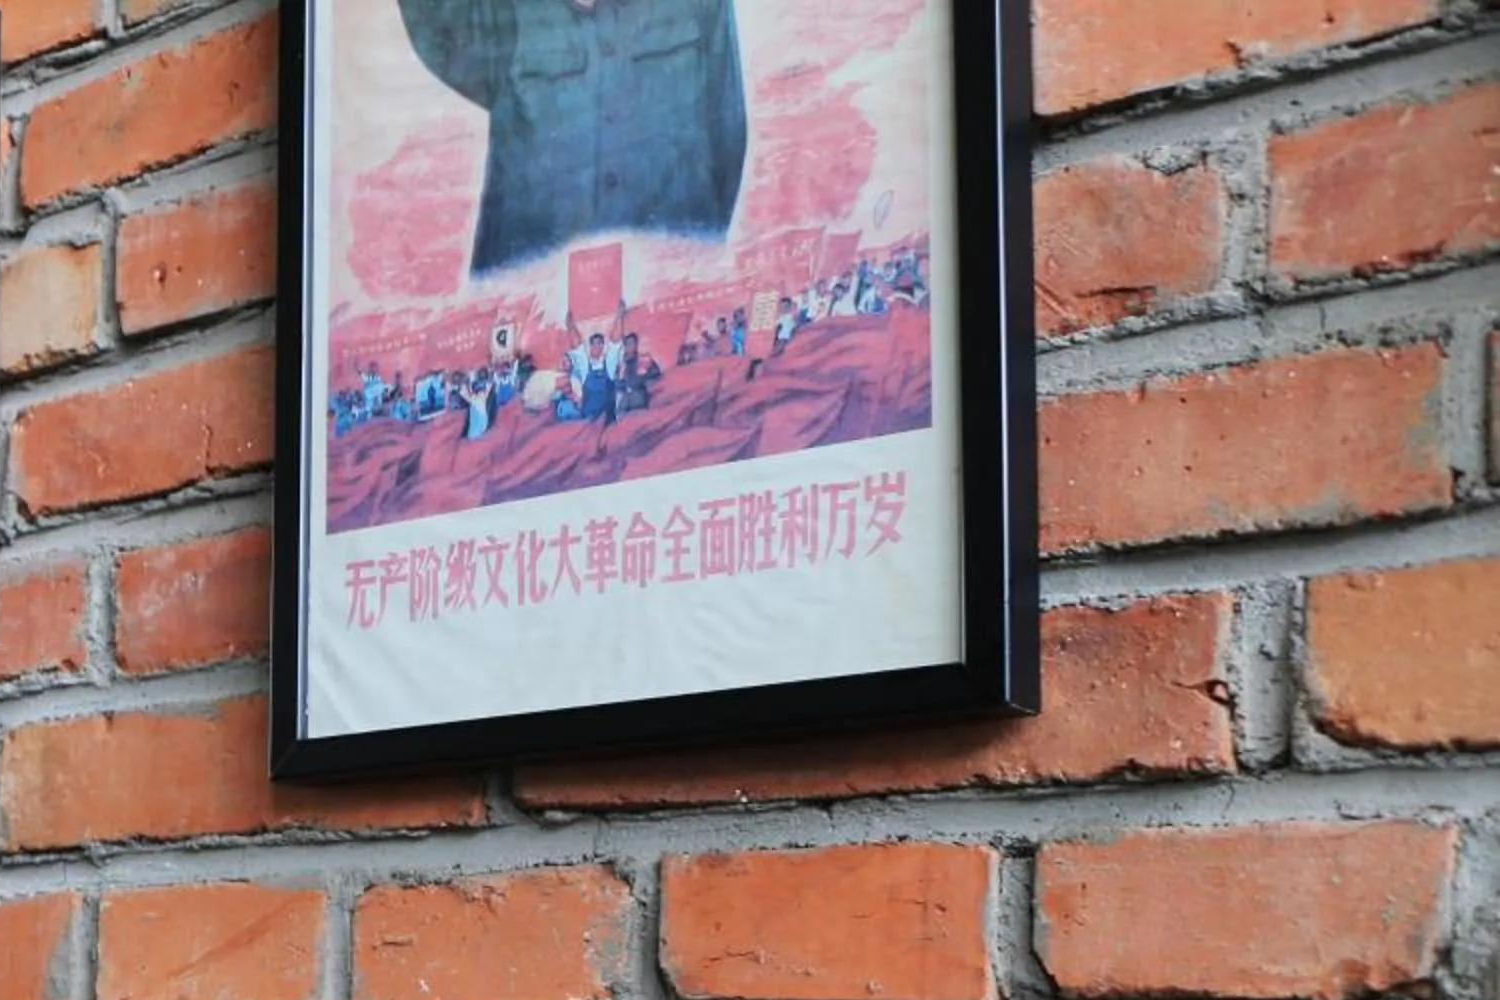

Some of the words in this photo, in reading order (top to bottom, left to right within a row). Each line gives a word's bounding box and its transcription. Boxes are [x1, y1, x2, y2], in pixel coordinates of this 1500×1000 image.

[346, 471, 907, 630] 无产阶级文化大革命全面胜利万岁
